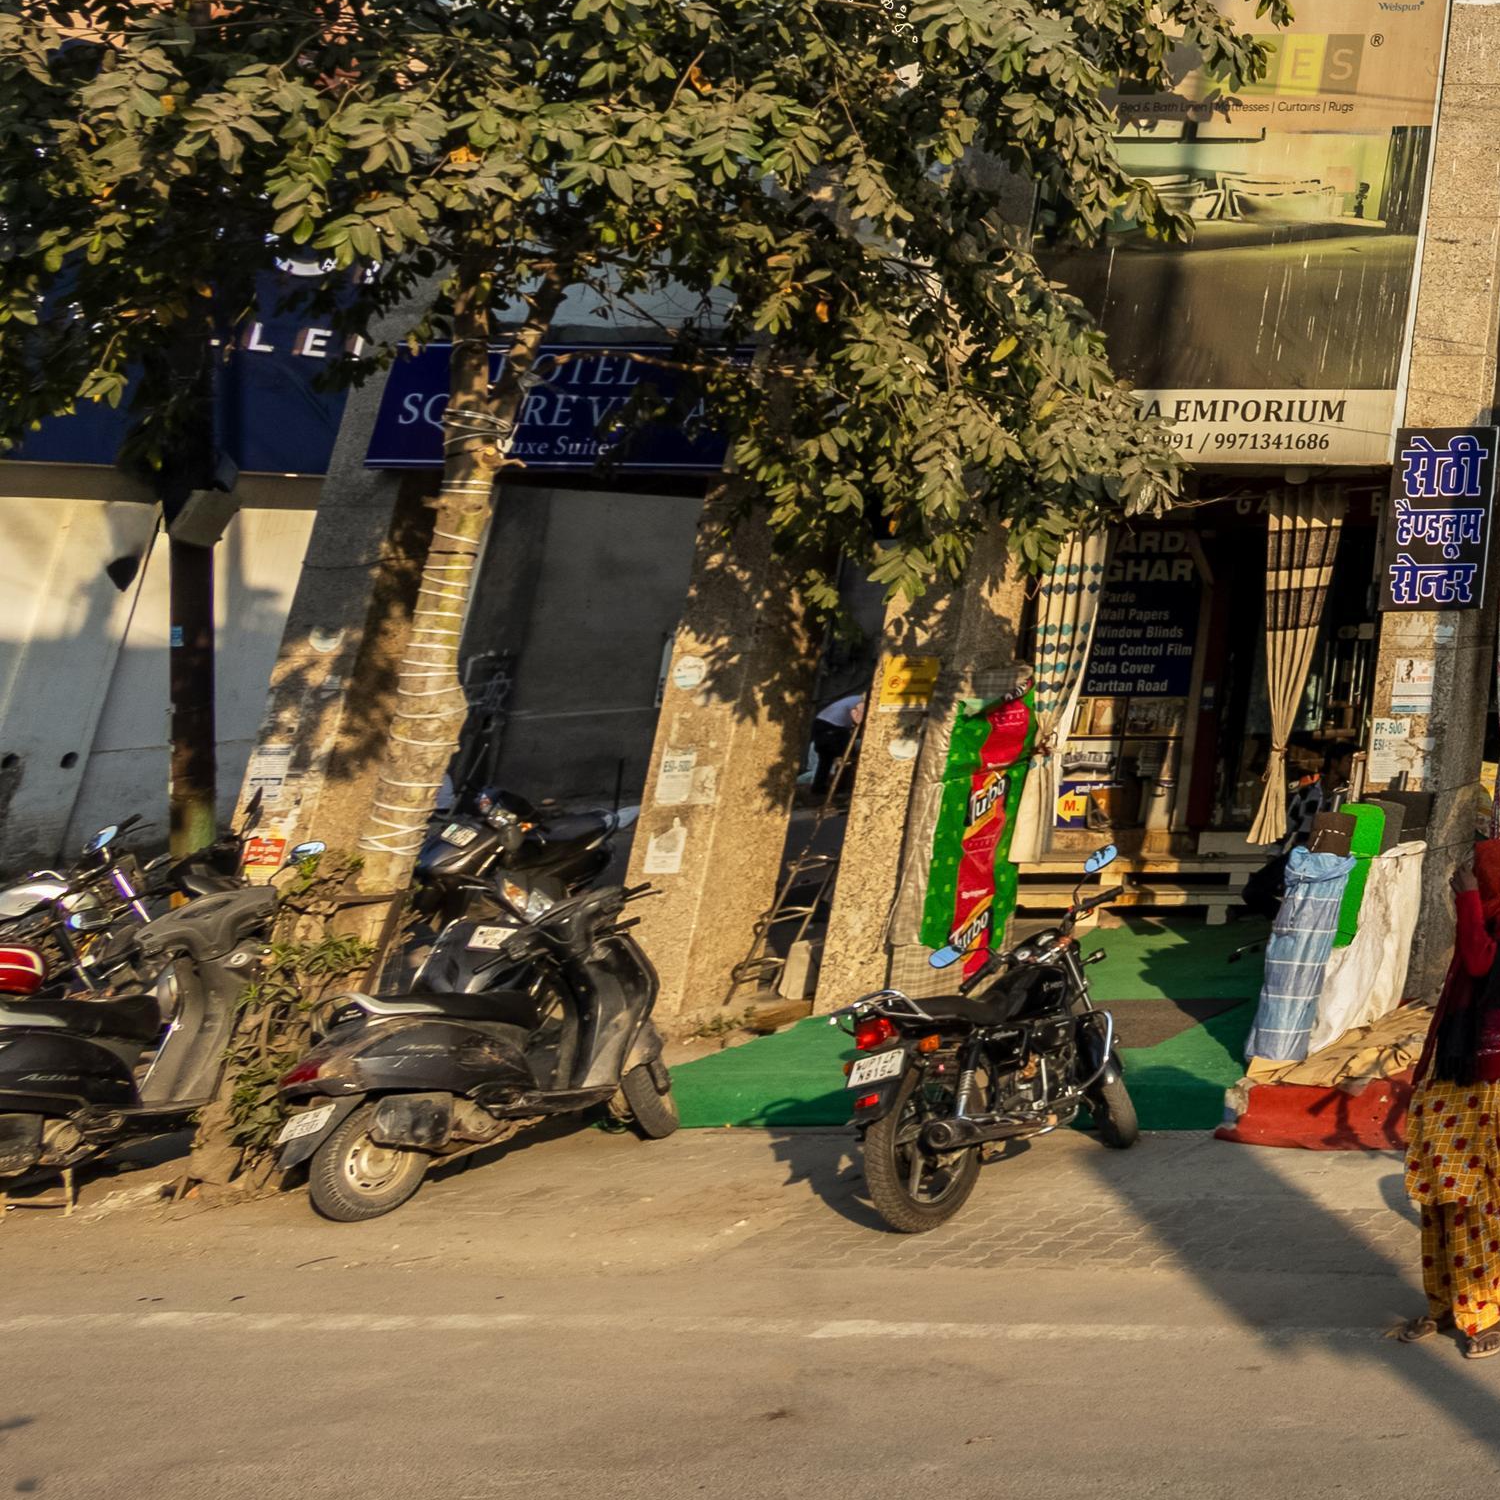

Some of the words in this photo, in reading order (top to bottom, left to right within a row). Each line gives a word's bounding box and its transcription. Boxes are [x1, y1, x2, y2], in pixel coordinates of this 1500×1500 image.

[1378, 1, 1421, 15] Welspun
[1153, 101, 1178, 113] Bath
[1277, 101, 1321, 113] Curtains
[1328, 101, 1354, 114] Rugs
[1174, 399, 1347, 423] EMPORIUM
[1214, 432, 1330, 450] 9971341686
[1401, 435, 1488, 498] सेठी
[1106, 559, 1195, 581] GHAR
[1100, 608, 1125, 620] Wall
[1128, 608, 1171, 623] Papers
[1096, 626, 1143, 638] Window
[1146, 625, 1184, 638] Blinds
[1093, 644, 1115, 656] Sun
[1119, 643, 1163, 656] Control
[1166, 643, 1193, 656] Film
[1090, 661, 1116, 674] Sofa
[1121, 661, 1155, 674] Cover
[1087, 680, 1132, 692] Carttan
[1137, 679, 1168, 692] Road
[967, 772, 1006, 825] Turbo
